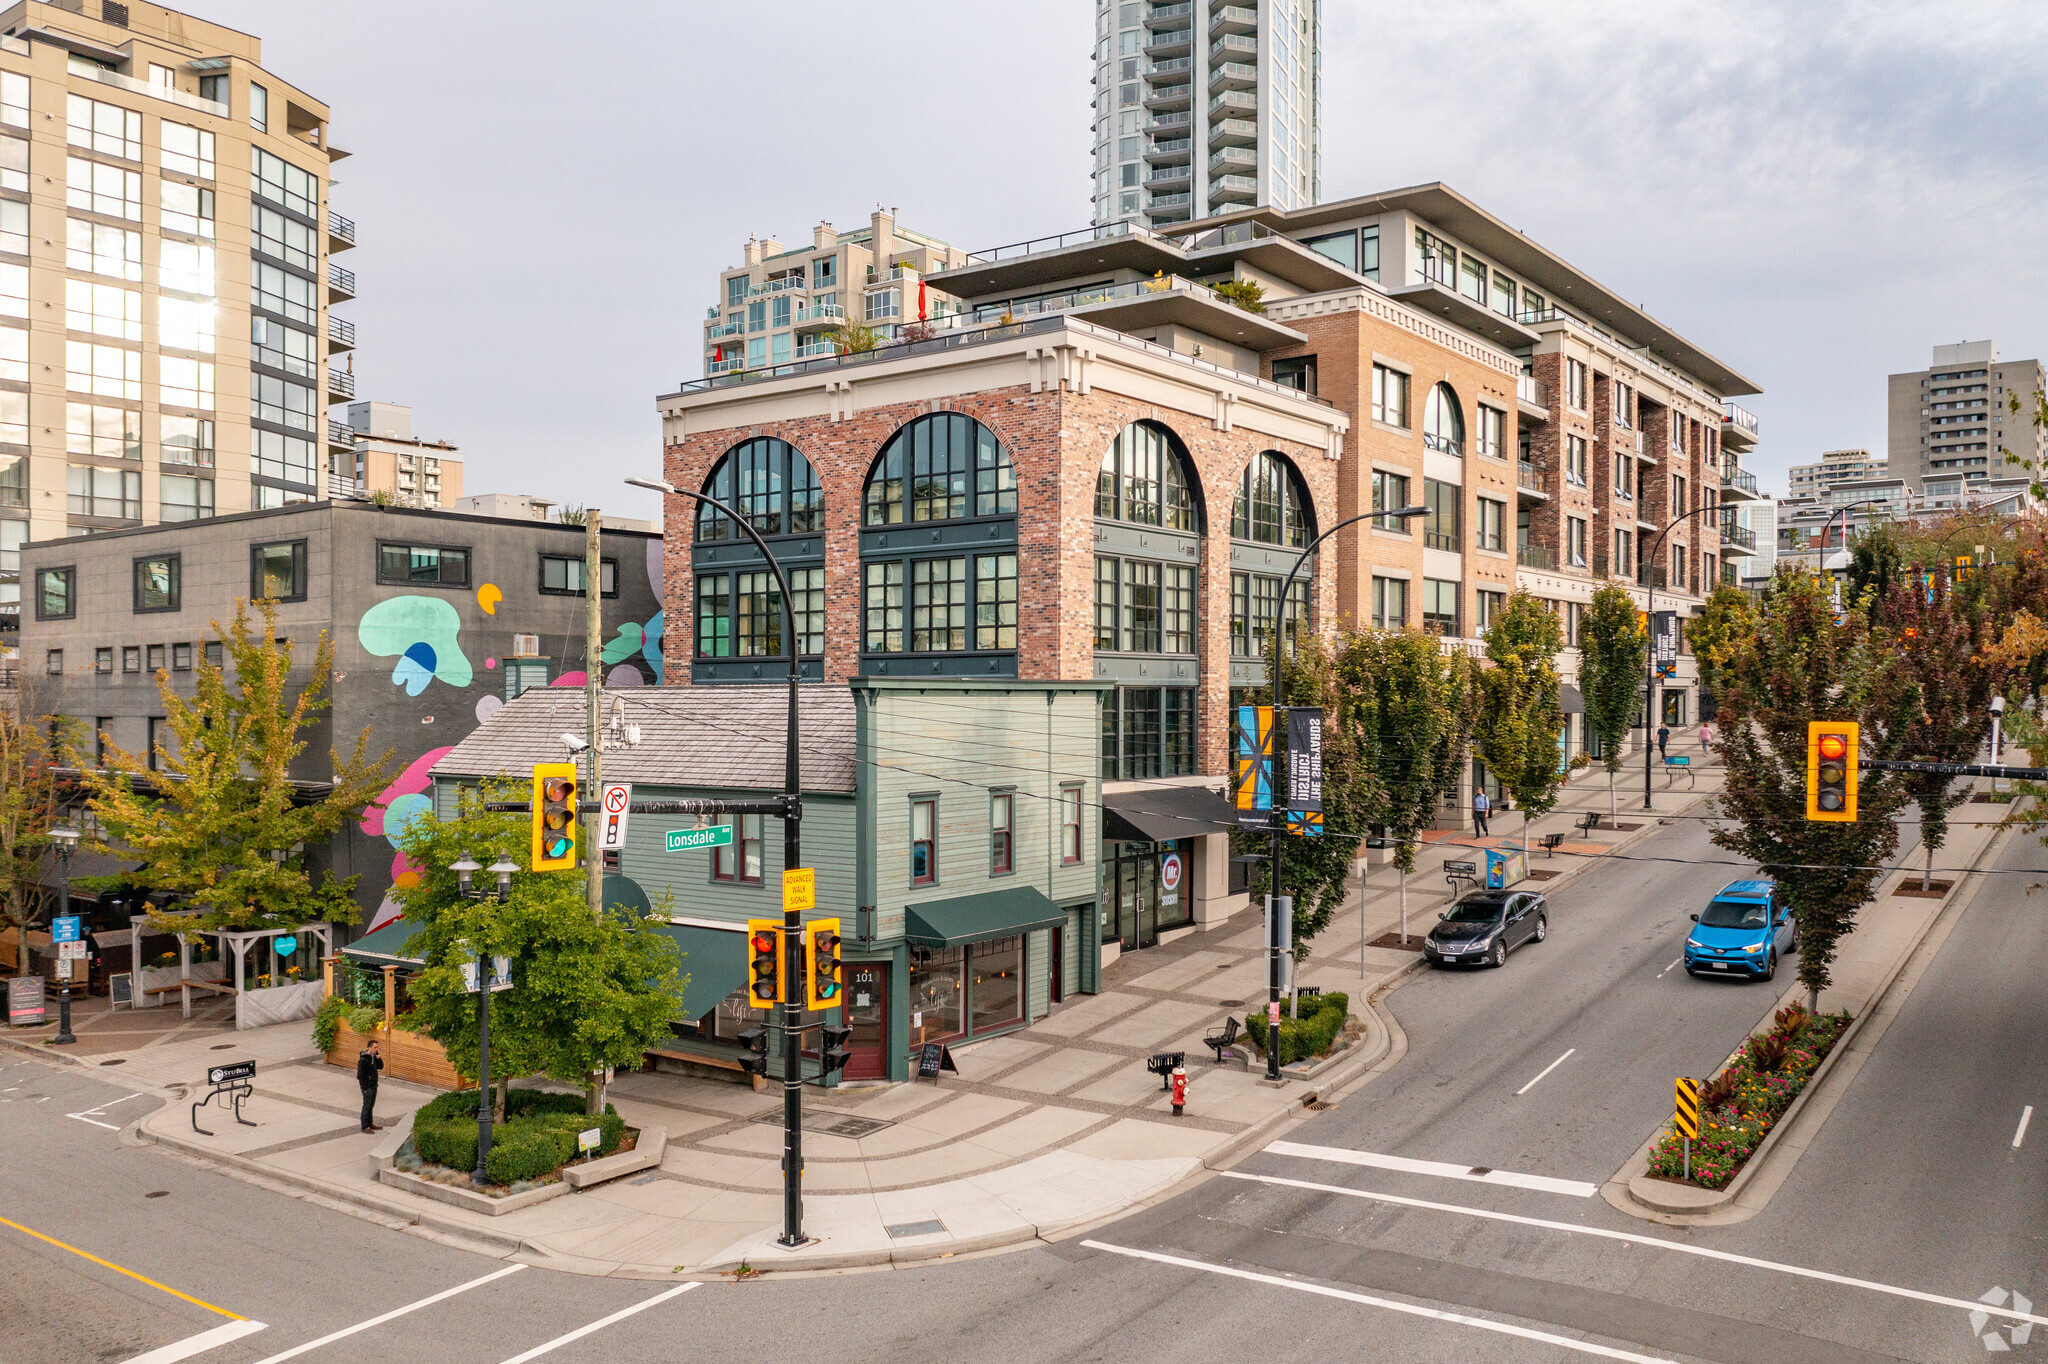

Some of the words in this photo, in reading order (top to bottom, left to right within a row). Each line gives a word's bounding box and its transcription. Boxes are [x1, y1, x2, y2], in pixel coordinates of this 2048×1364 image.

[669, 830, 715, 848] Lonsdale
[721, 826, 731, 834] Ave
[1166, 865, 1178, 880] Mr.
[785, 874, 812, 885] ADVANCED
[792, 886, 806, 894] WALK
[790, 896, 808, 905] SIGNAL
[1162, 893, 1178, 907] SUSHI
[856, 973, 873, 983] 101
